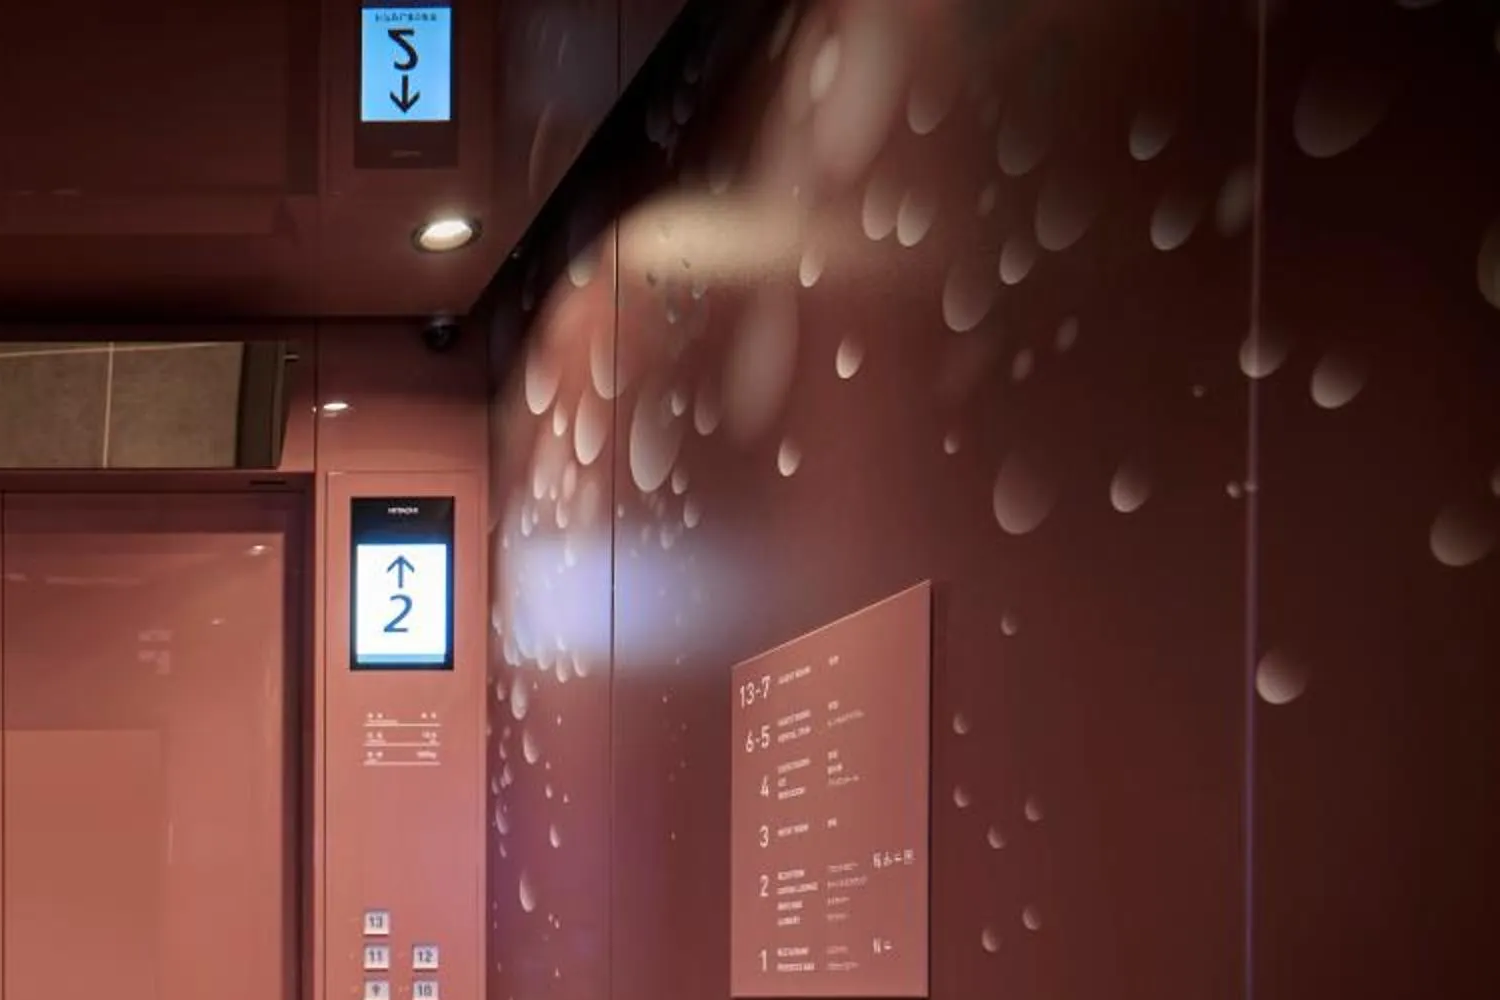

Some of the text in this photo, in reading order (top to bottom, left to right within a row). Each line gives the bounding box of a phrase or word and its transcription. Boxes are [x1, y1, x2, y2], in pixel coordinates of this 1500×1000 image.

[383, 594, 413, 633] 2
[740, 675, 771, 709] 13-7
[745, 725, 770, 753] 6-5
[760, 775, 769, 797] 4
[759, 825, 769, 848] 3
[759, 875, 769, 897] 2
[369, 949, 382, 962] 11
[418, 949, 433, 963] 12
[759, 950, 767, 971] 1
[418, 984, 432, 997] 10
